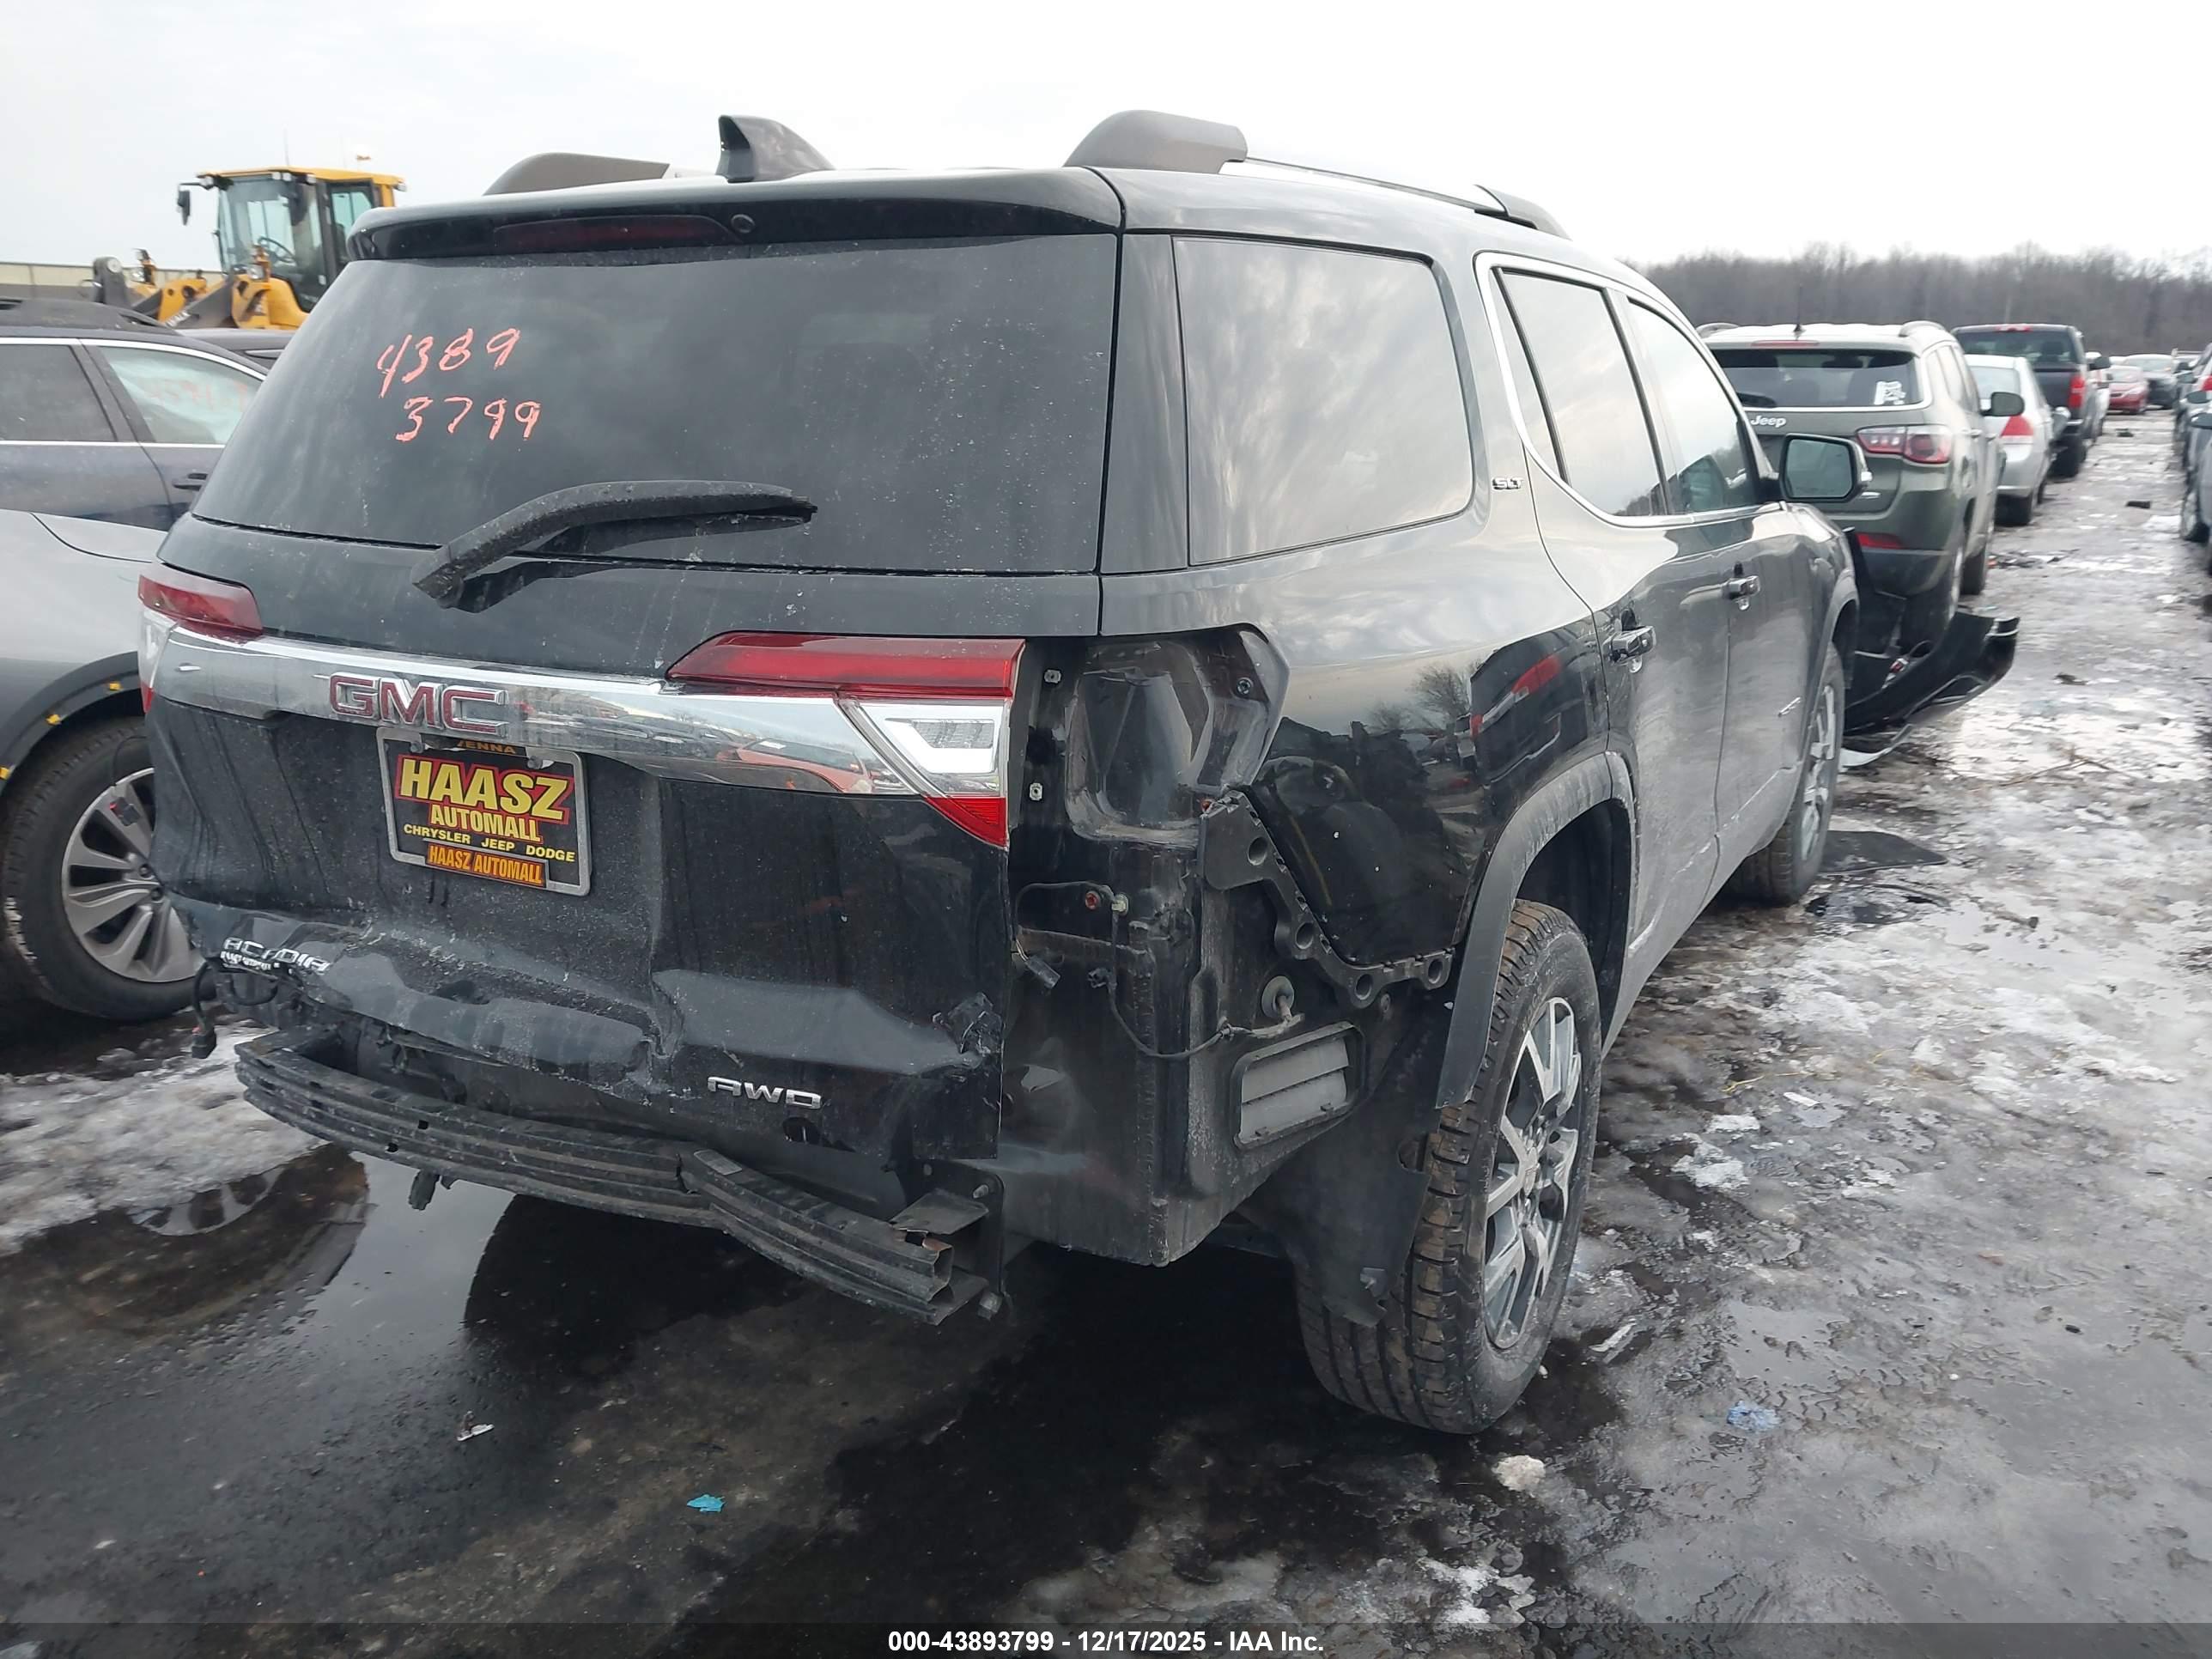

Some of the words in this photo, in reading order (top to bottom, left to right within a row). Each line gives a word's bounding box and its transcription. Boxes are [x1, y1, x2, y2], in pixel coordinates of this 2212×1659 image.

[376, 327, 520, 398] 4389
[395, 397, 541, 441] 3799
[1750, 415, 1787, 428] Jeep
[1492, 477, 1524, 489] SLT
[329, 672, 509, 738] GMC
[399, 758, 568, 821] HAASZ
[403, 823, 471, 845] CHRYSLER
[481, 837, 515, 852] JEEP
[526, 845, 575, 862] DODGE
[430, 804, 541, 842] AUTOMALL
[429, 845, 471, 870] HAASZ
[474, 854, 543, 884] AUTOMALL
[708, 1076, 822, 1109] AWD
